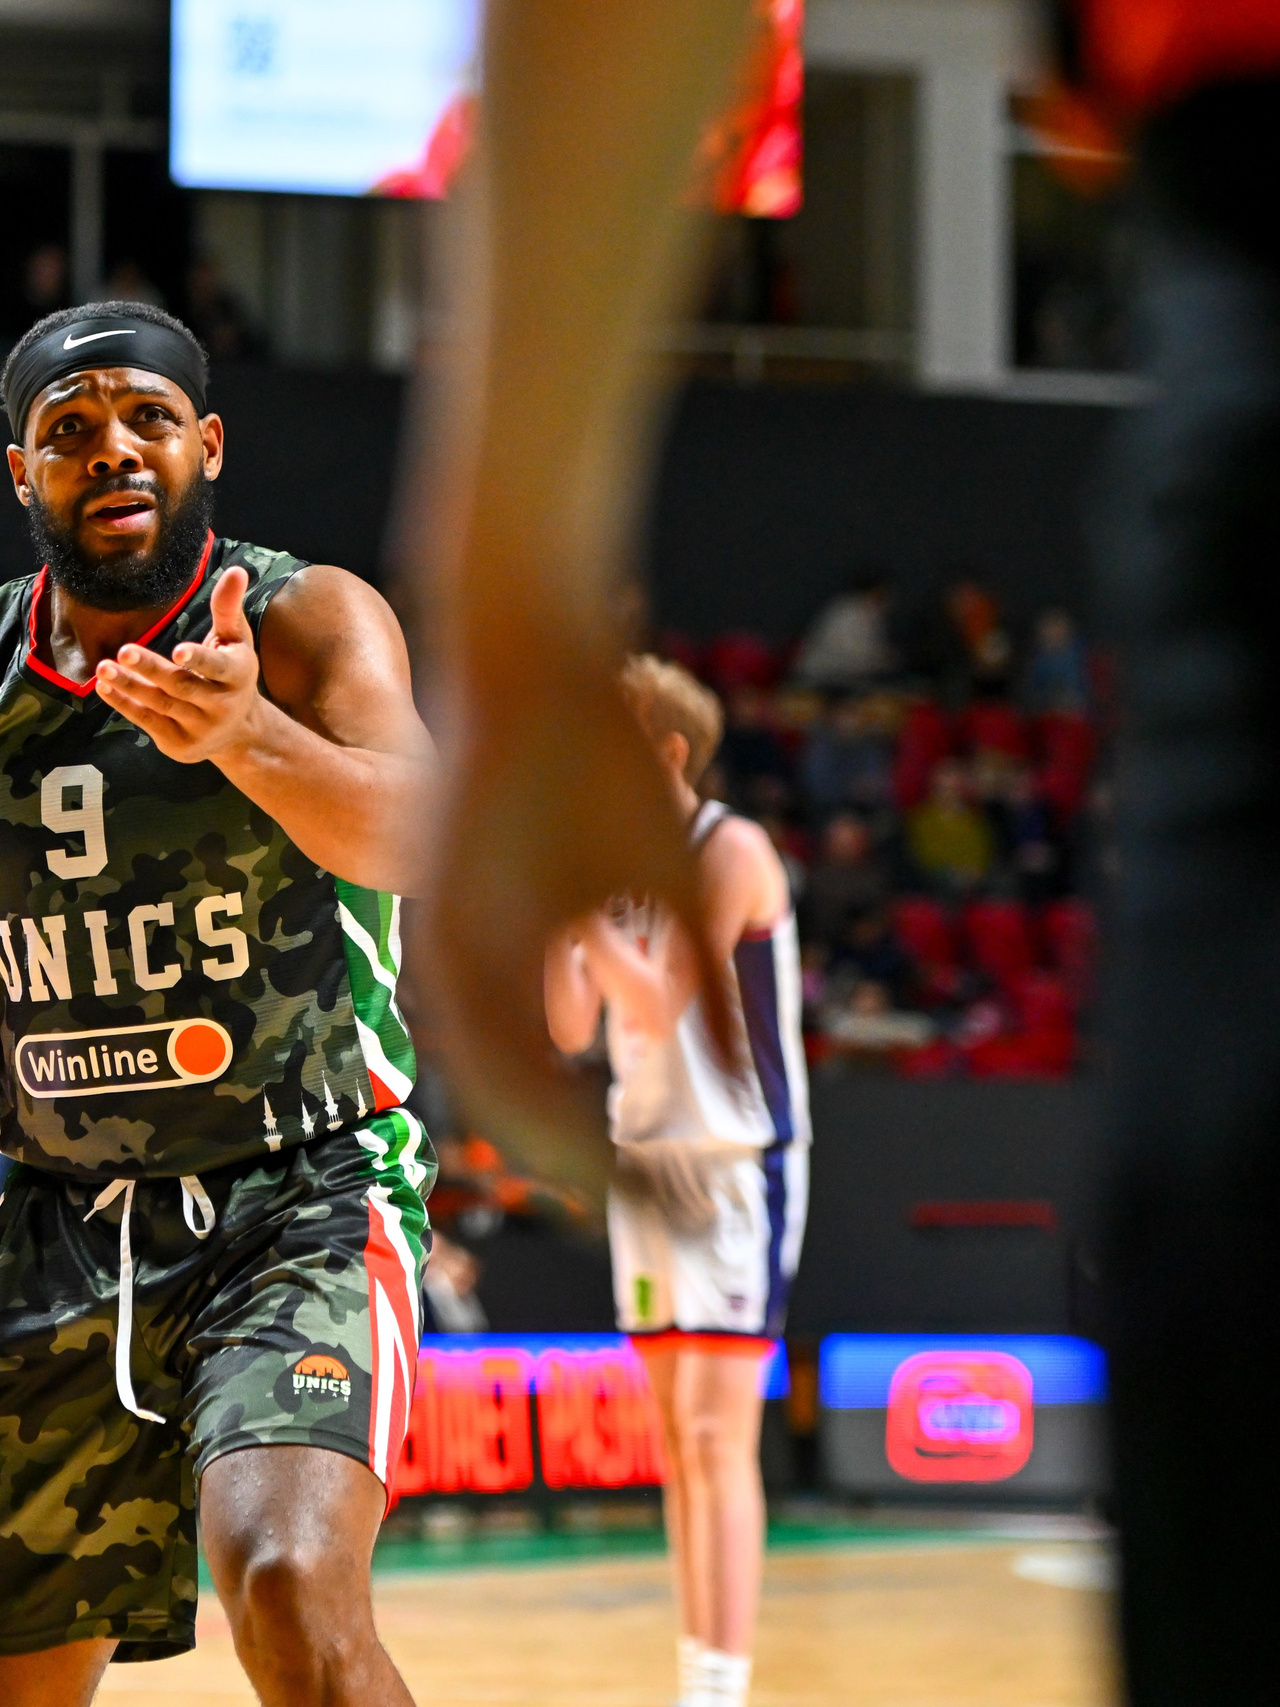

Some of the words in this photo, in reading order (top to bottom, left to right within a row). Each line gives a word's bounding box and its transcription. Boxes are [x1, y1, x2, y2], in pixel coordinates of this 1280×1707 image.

[40, 764, 108, 880] 9
[27, 1044, 159, 1082] Winline
[293, 1374, 351, 1396] UNICS
